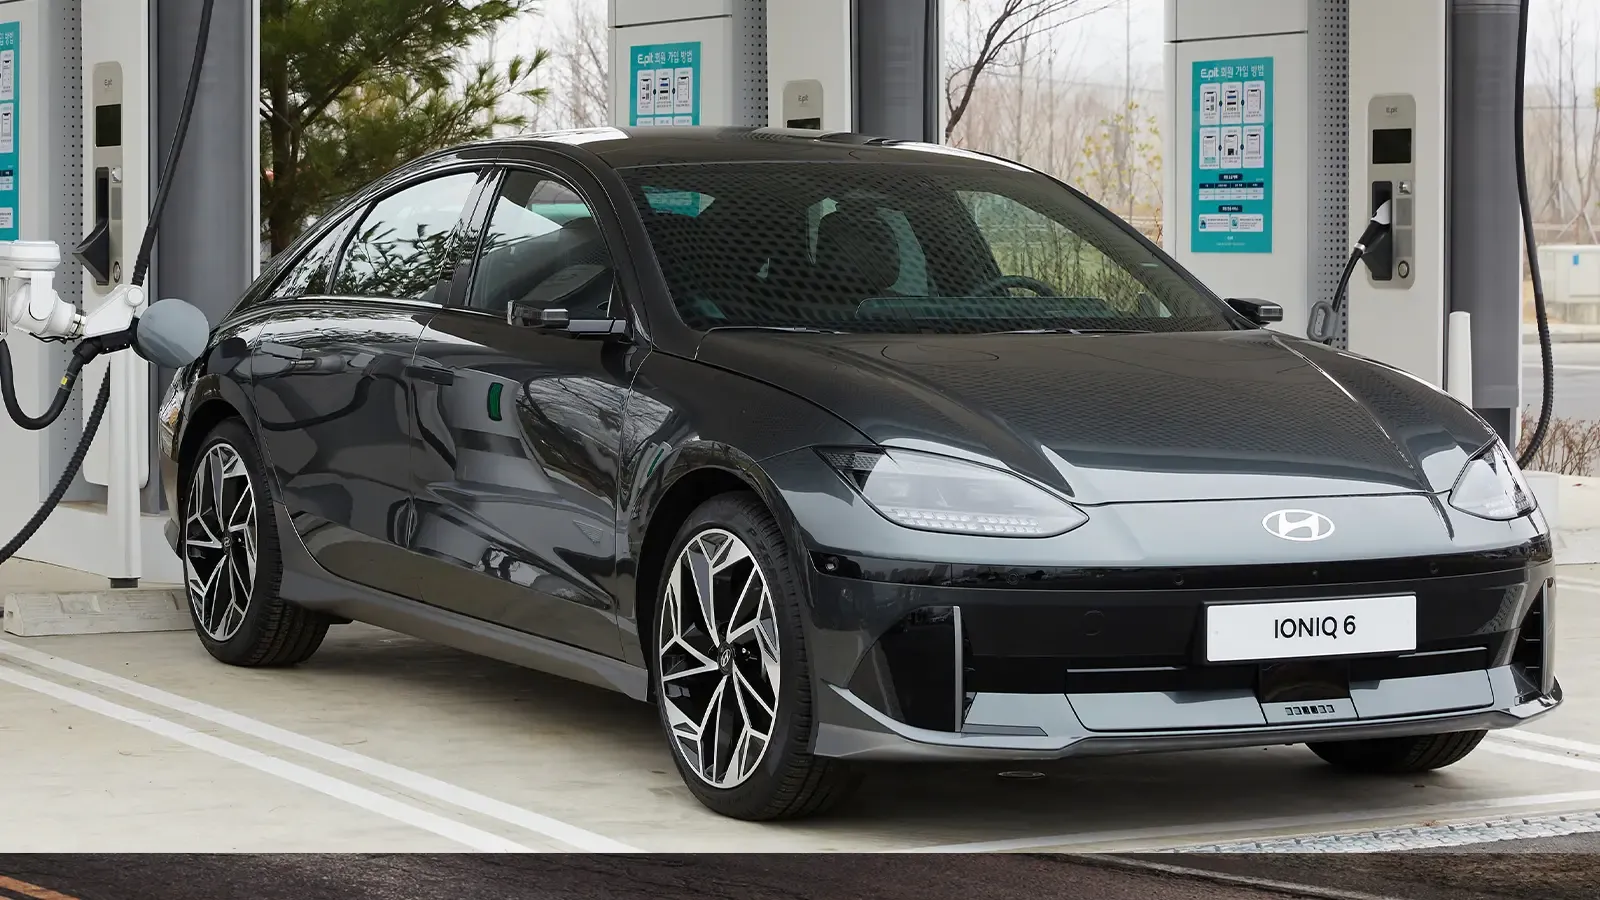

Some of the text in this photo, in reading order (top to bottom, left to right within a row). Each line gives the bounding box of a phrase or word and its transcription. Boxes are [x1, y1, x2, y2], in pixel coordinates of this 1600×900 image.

[1220, 65, 1234, 78] 회원
[1235, 64, 1249, 78] 가입
[1250, 64, 1265, 77] 방법
[1274, 615, 1356, 640] IONIQ 6
